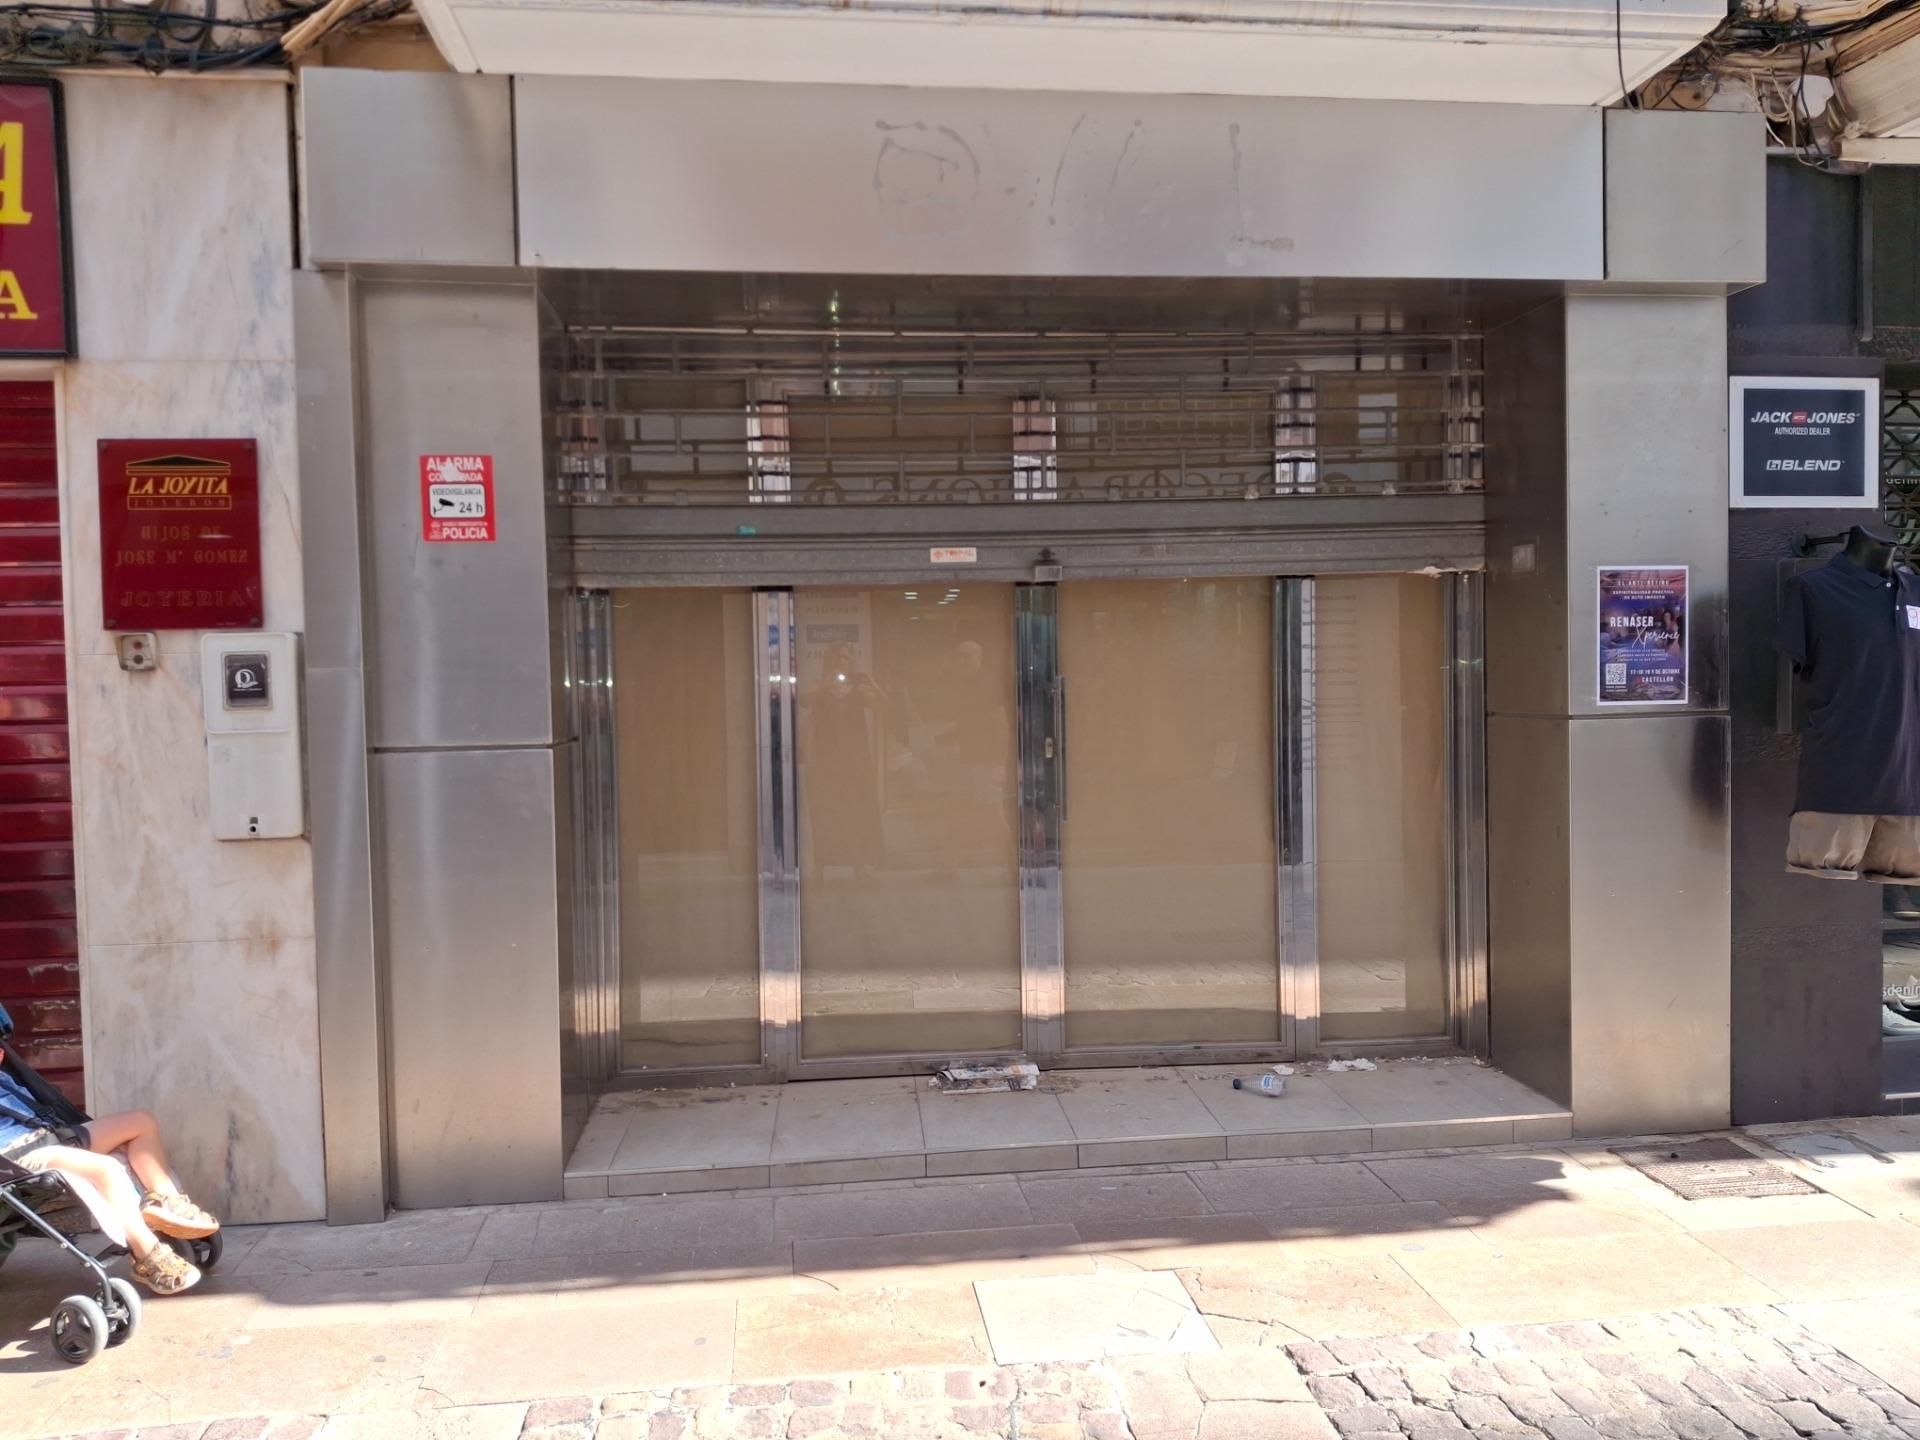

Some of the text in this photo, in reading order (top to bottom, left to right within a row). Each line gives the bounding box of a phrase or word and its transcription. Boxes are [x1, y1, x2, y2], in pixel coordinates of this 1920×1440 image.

[1751, 411, 1792, 423] JACK
[1807, 412, 1857, 424] JONES
[1774, 427, 1831, 436] AUTHORIZED DEALER
[426, 457, 484, 471] ALARMA
[1781, 459, 1841, 471] BLEND
[128, 476, 228, 494] LA JOYITA
[459, 502, 484, 513] 24 h
[140, 526, 191, 541] HIJOS
[442, 527, 489, 540] POLICIA
[114, 550, 156, 567] JOSE
[120, 590, 247, 607] JOYERIA
[1610, 615, 1654, 628] RENASER
